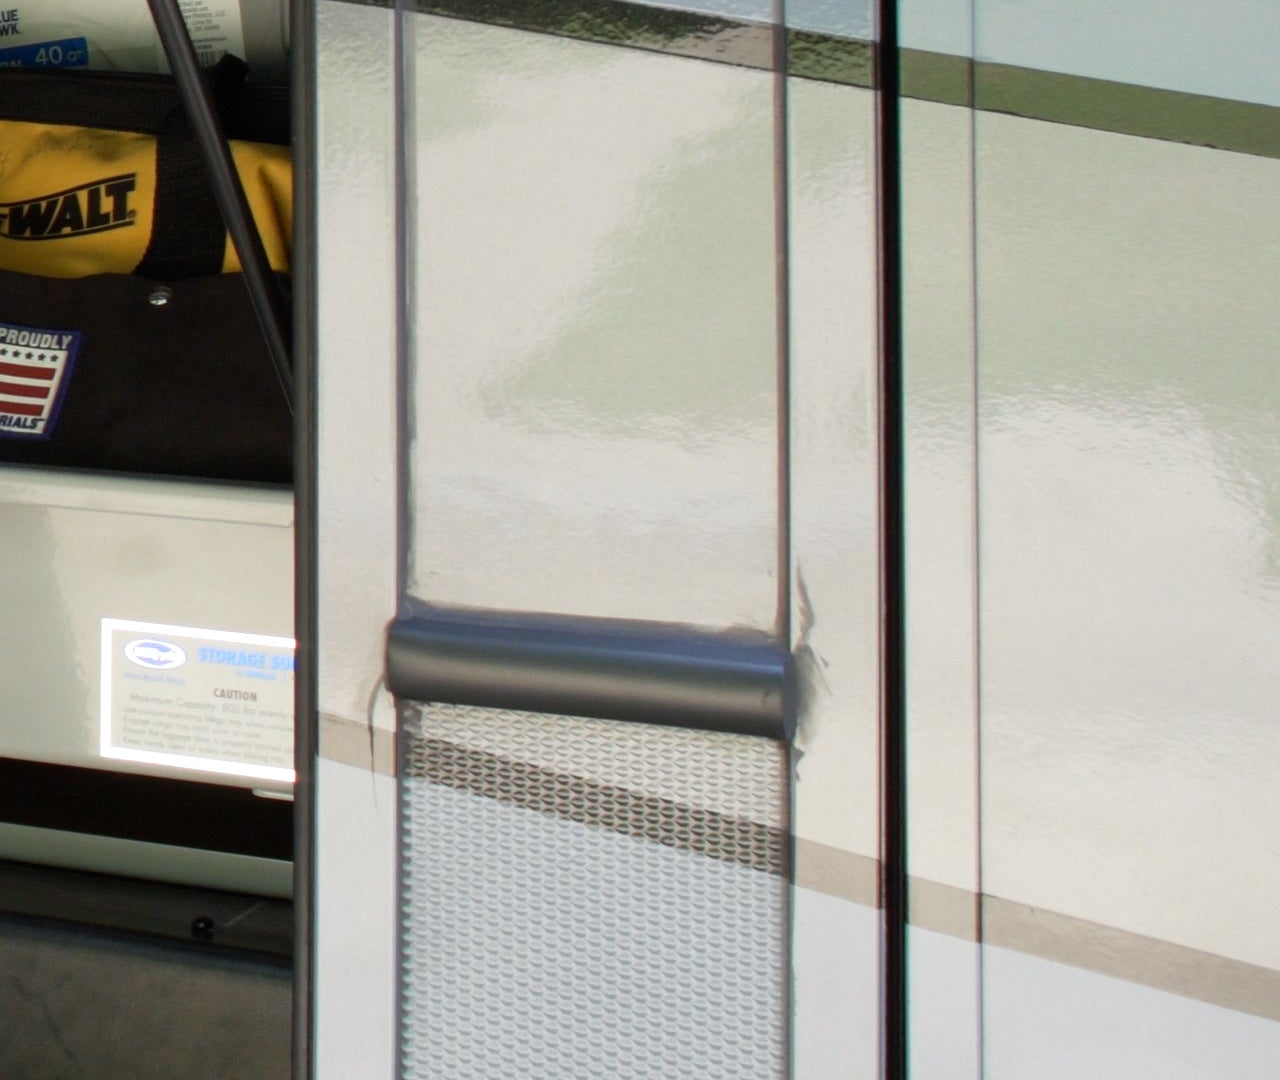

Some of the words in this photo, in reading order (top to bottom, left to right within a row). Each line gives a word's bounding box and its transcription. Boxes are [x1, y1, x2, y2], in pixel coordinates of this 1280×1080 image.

[34, 46, 62, 64] 40
[67, 49, 83, 62] QT
[198, 648, 266, 668] STORAGE
[213, 688, 257, 702] CAUTION
